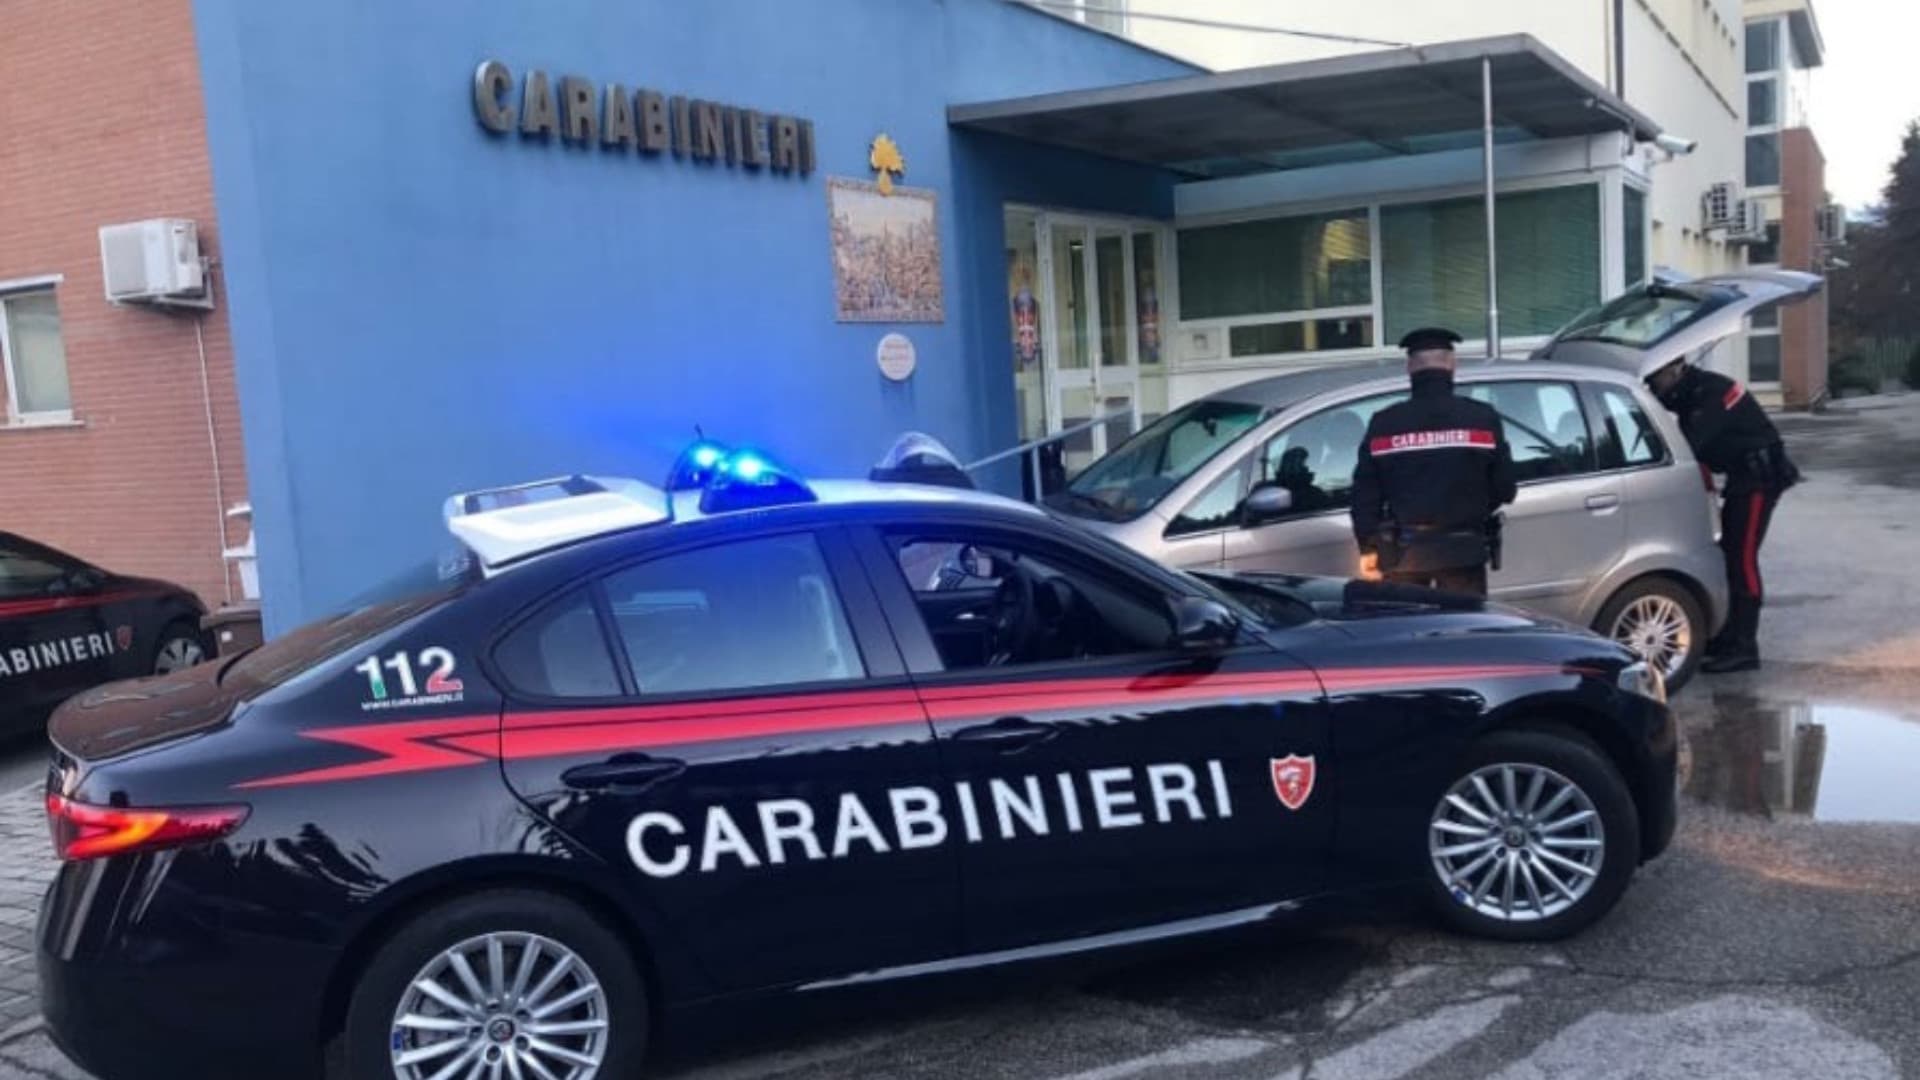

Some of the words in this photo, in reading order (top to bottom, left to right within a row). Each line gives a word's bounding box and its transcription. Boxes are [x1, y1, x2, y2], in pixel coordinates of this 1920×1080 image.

[474, 60, 815, 174] CARABINIERI
[1391, 429, 1470, 448] CARABINIERI
[355, 645, 464, 699] 112
[625, 759, 1233, 878] CARABINIERI
